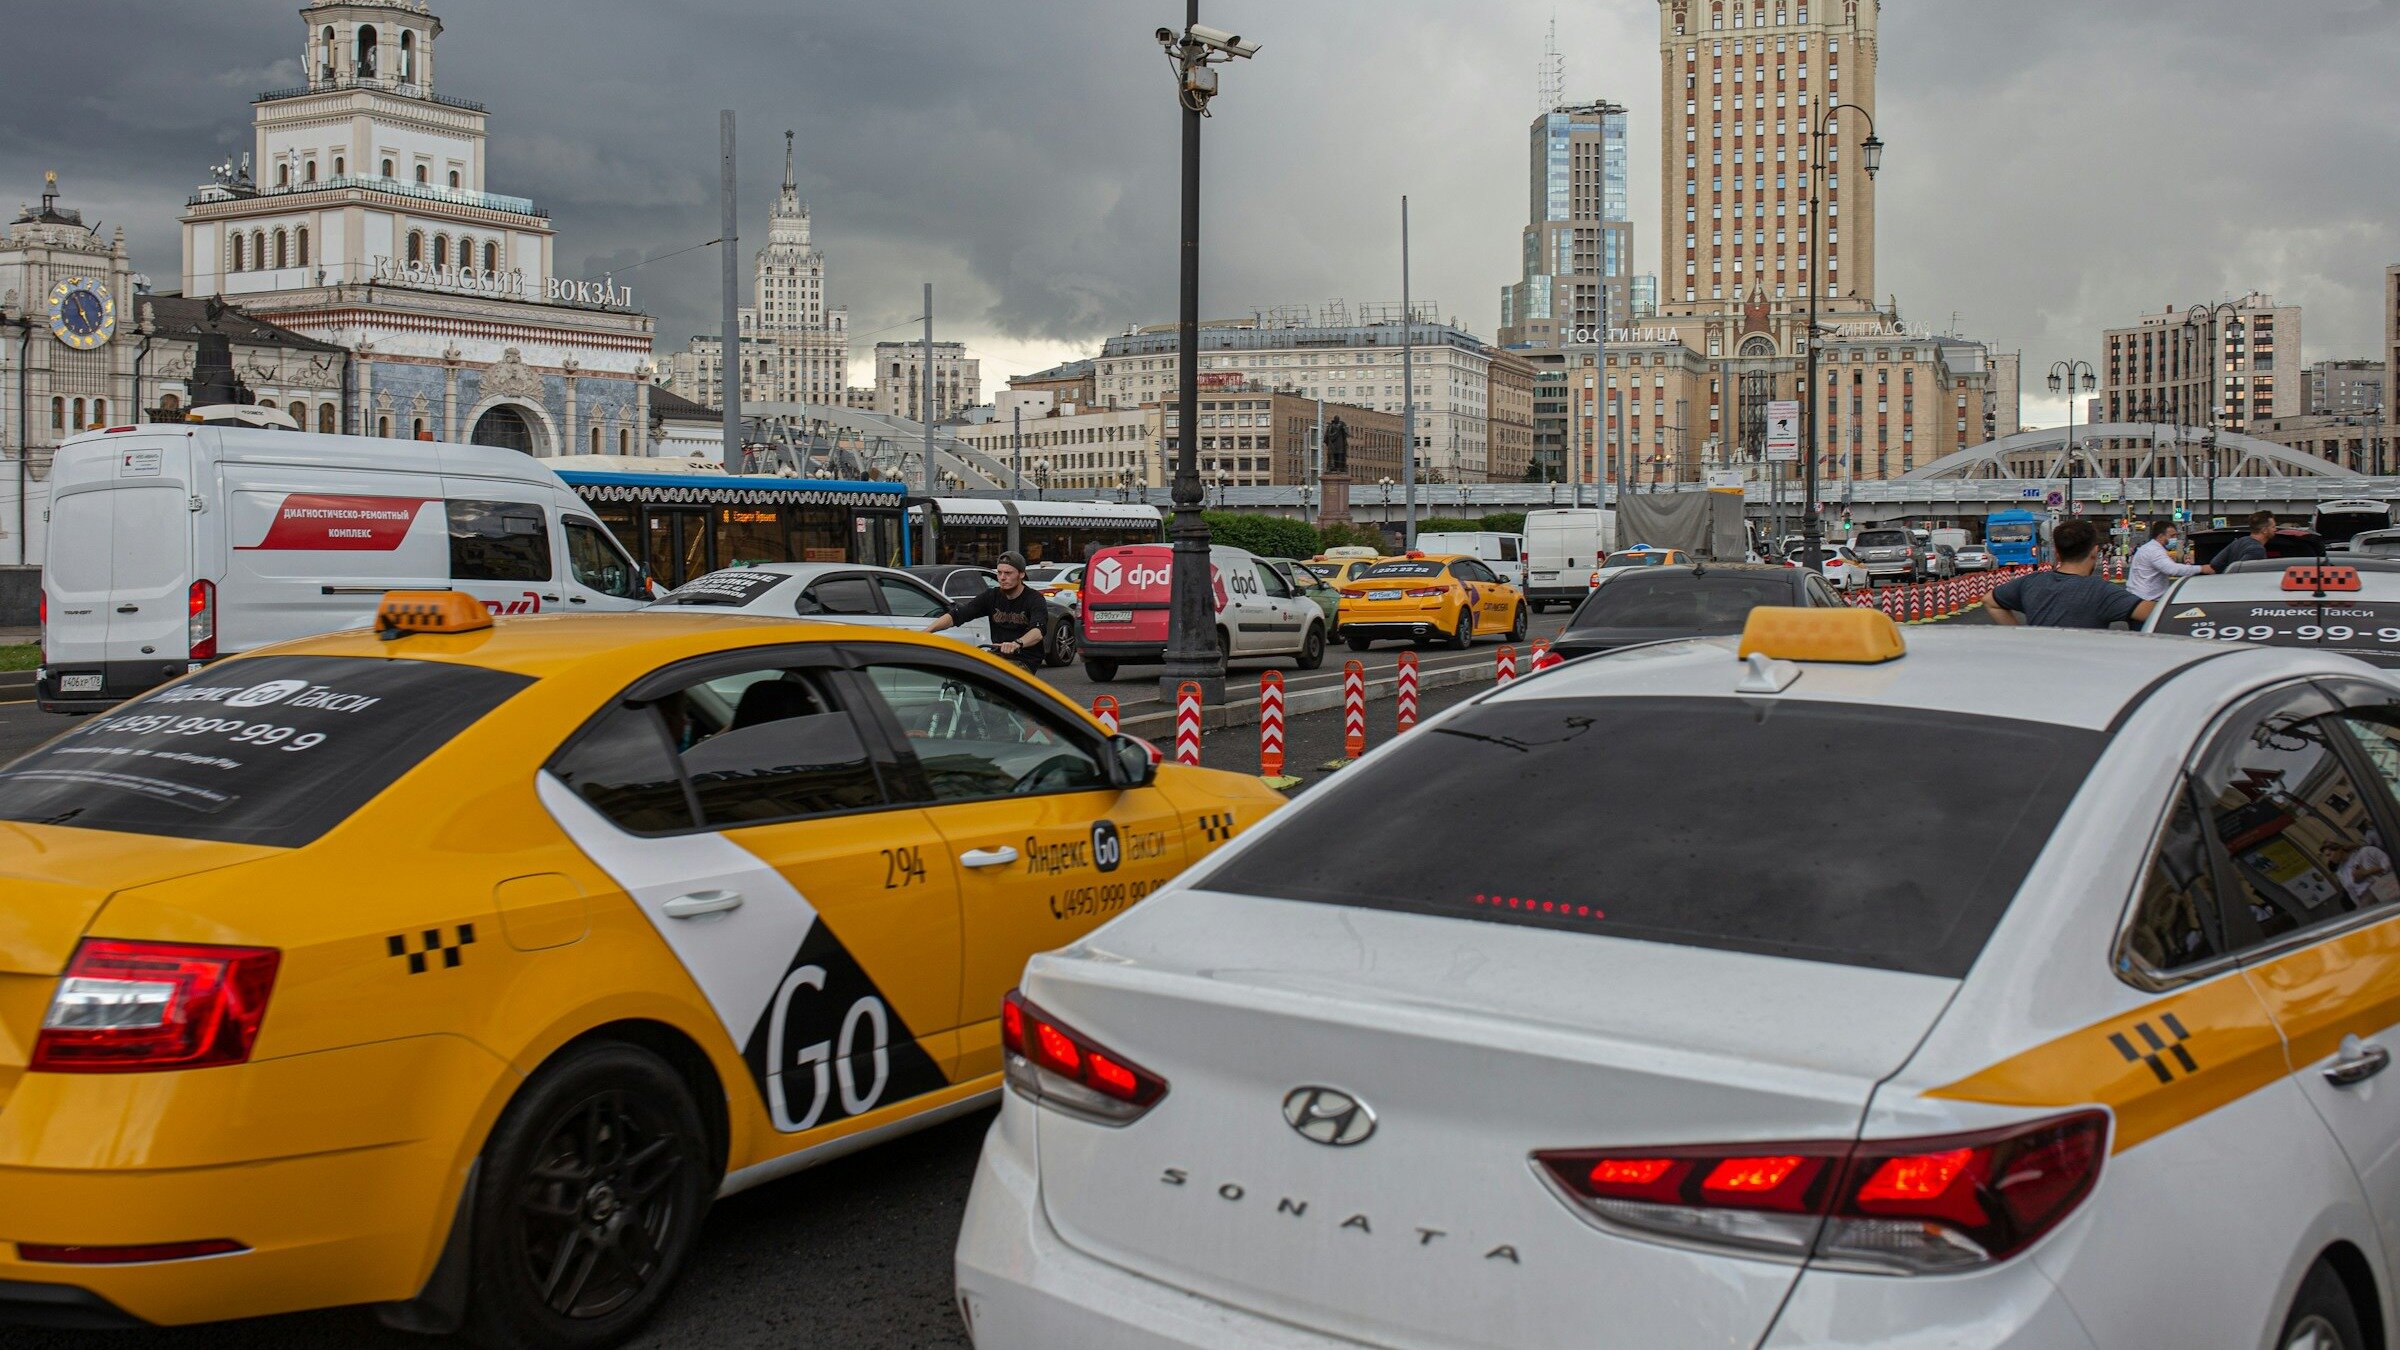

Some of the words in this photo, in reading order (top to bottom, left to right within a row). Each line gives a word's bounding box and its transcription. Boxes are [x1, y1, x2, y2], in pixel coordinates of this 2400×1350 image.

[374, 254, 528, 295] КАЗАНСКИЙ
[545, 275, 632, 307] ВОКЗАЛ
[1568, 327, 1679, 342] ГОСТИНИЦА
[284, 508, 410, 520] ДИАГНОСТИЧЕСКО-РЕМОНТНЫЙ
[328, 528, 372, 538] КОМПЛЕКС
[1127, 563, 1171, 590] dpd
[1231, 568, 1258, 600] dpd
[2250, 607, 2318, 618] Яндекс
[2322, 607, 2375, 618] Такси
[283, 685, 382, 714] Такси
[1026, 835, 1089, 876] Яндекс
[1093, 826, 1120, 866] Go
[1121, 825, 1166, 861] Такси
[881, 845, 926, 890] 294
[1063, 885, 1099, 919] (495)
[1100, 882, 1126, 912] 999
[767, 963, 890, 1133] Go
[1160, 1167, 1521, 1265] SONATA
